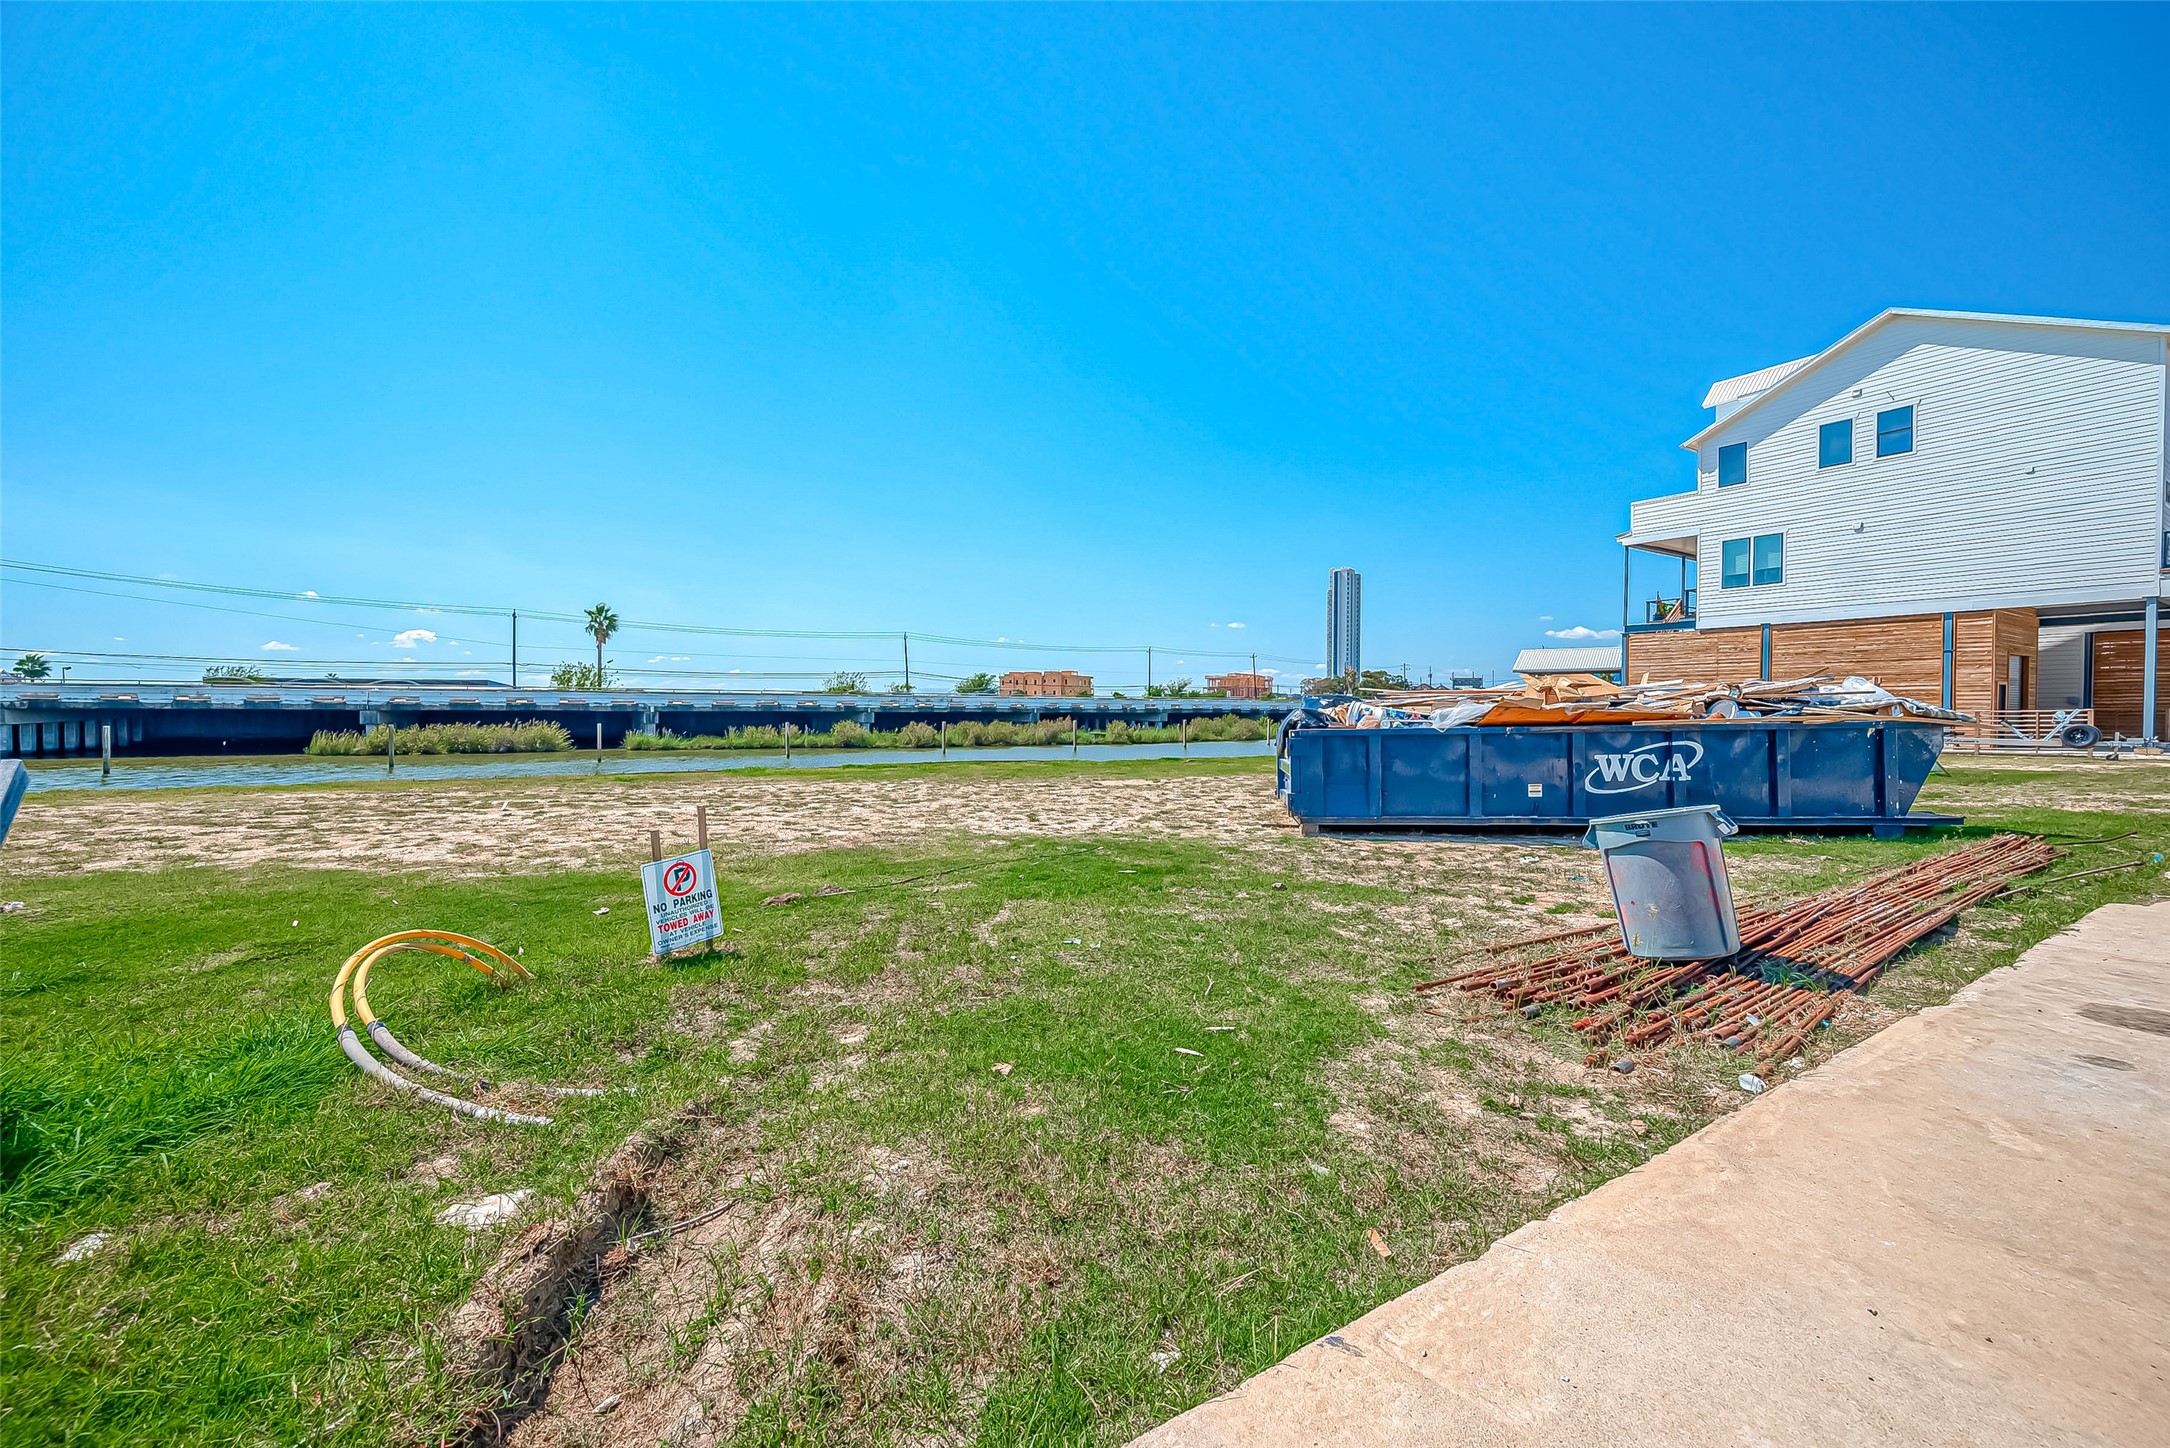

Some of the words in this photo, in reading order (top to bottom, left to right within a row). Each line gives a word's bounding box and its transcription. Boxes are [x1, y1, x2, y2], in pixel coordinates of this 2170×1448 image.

[1594, 753, 1692, 782] WCA
[1624, 821, 1659, 831] BRUTE
[653, 902, 667, 914] NO
[673, 889, 713, 908] PARKING
[660, 900, 709, 918] UNAUTHORIZED
[656, 912, 688, 925] VEHICLES
[689, 907, 704, 915] WILL
[657, 917, 689, 934] TOWED
[693, 909, 714, 923] AWAY
[657, 932, 689, 946] OWNER'S
[690, 922, 718, 936] EXPENSE
[680, 921, 706, 933] VEHICLE
